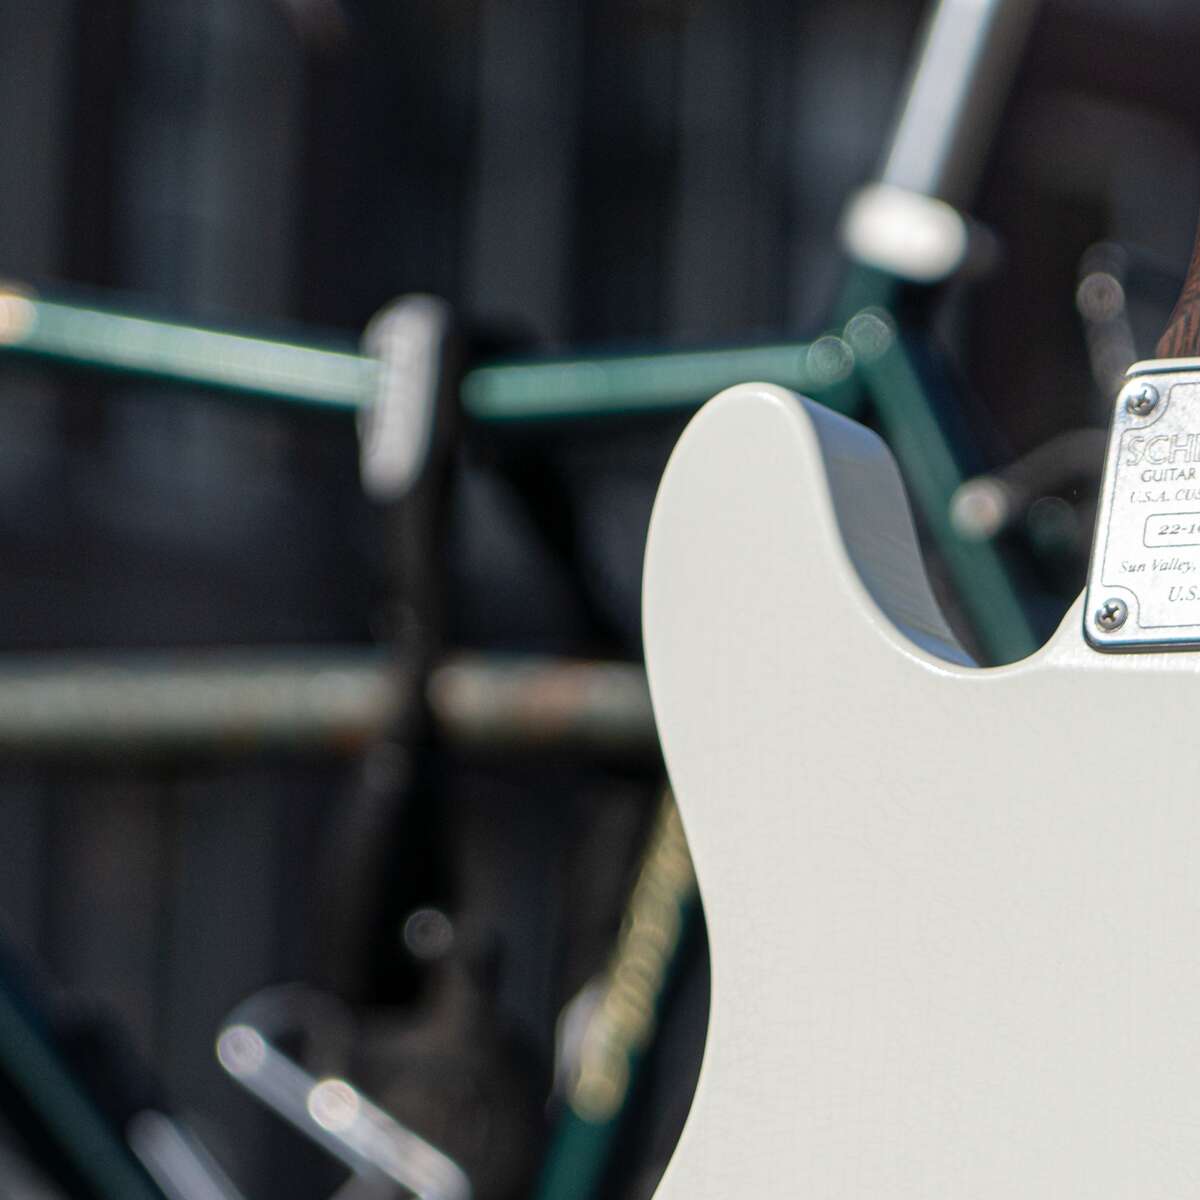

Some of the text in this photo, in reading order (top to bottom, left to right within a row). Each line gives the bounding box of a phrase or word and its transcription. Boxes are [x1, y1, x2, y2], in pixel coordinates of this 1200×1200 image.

[1140, 467, 1197, 483] GUITAR
[1119, 560, 1146, 574] Sun
[1151, 557, 1197, 575] Valley,
